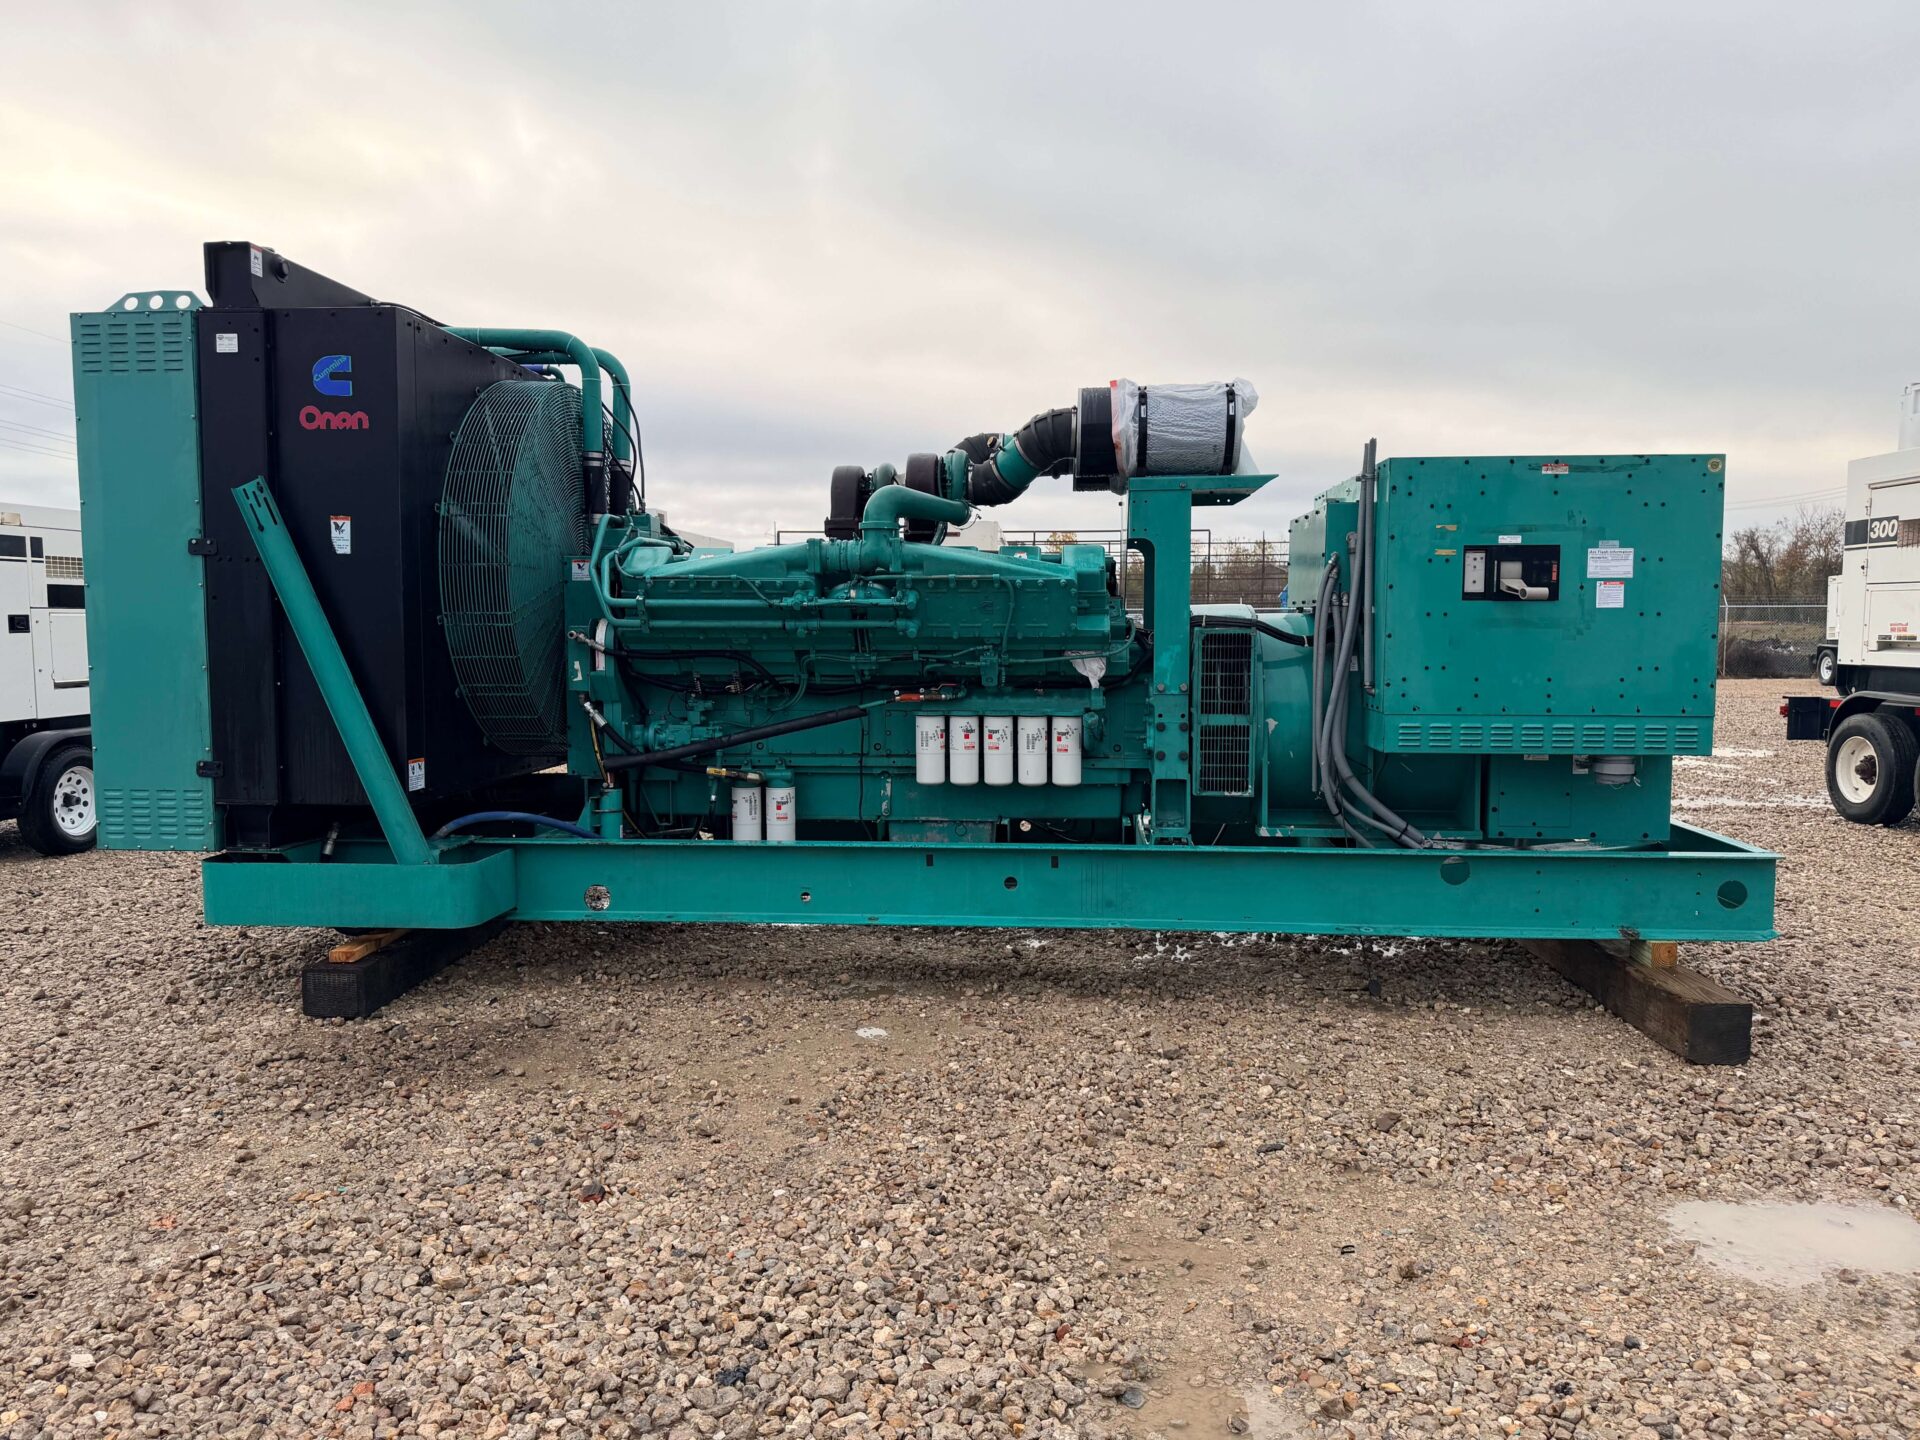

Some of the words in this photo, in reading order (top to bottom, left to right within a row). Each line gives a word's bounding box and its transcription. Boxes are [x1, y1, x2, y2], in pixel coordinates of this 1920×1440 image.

[313, 355, 347, 382] Cummins
[299, 405, 369, 430] Onan
[1870, 519, 1898, 539] 300
